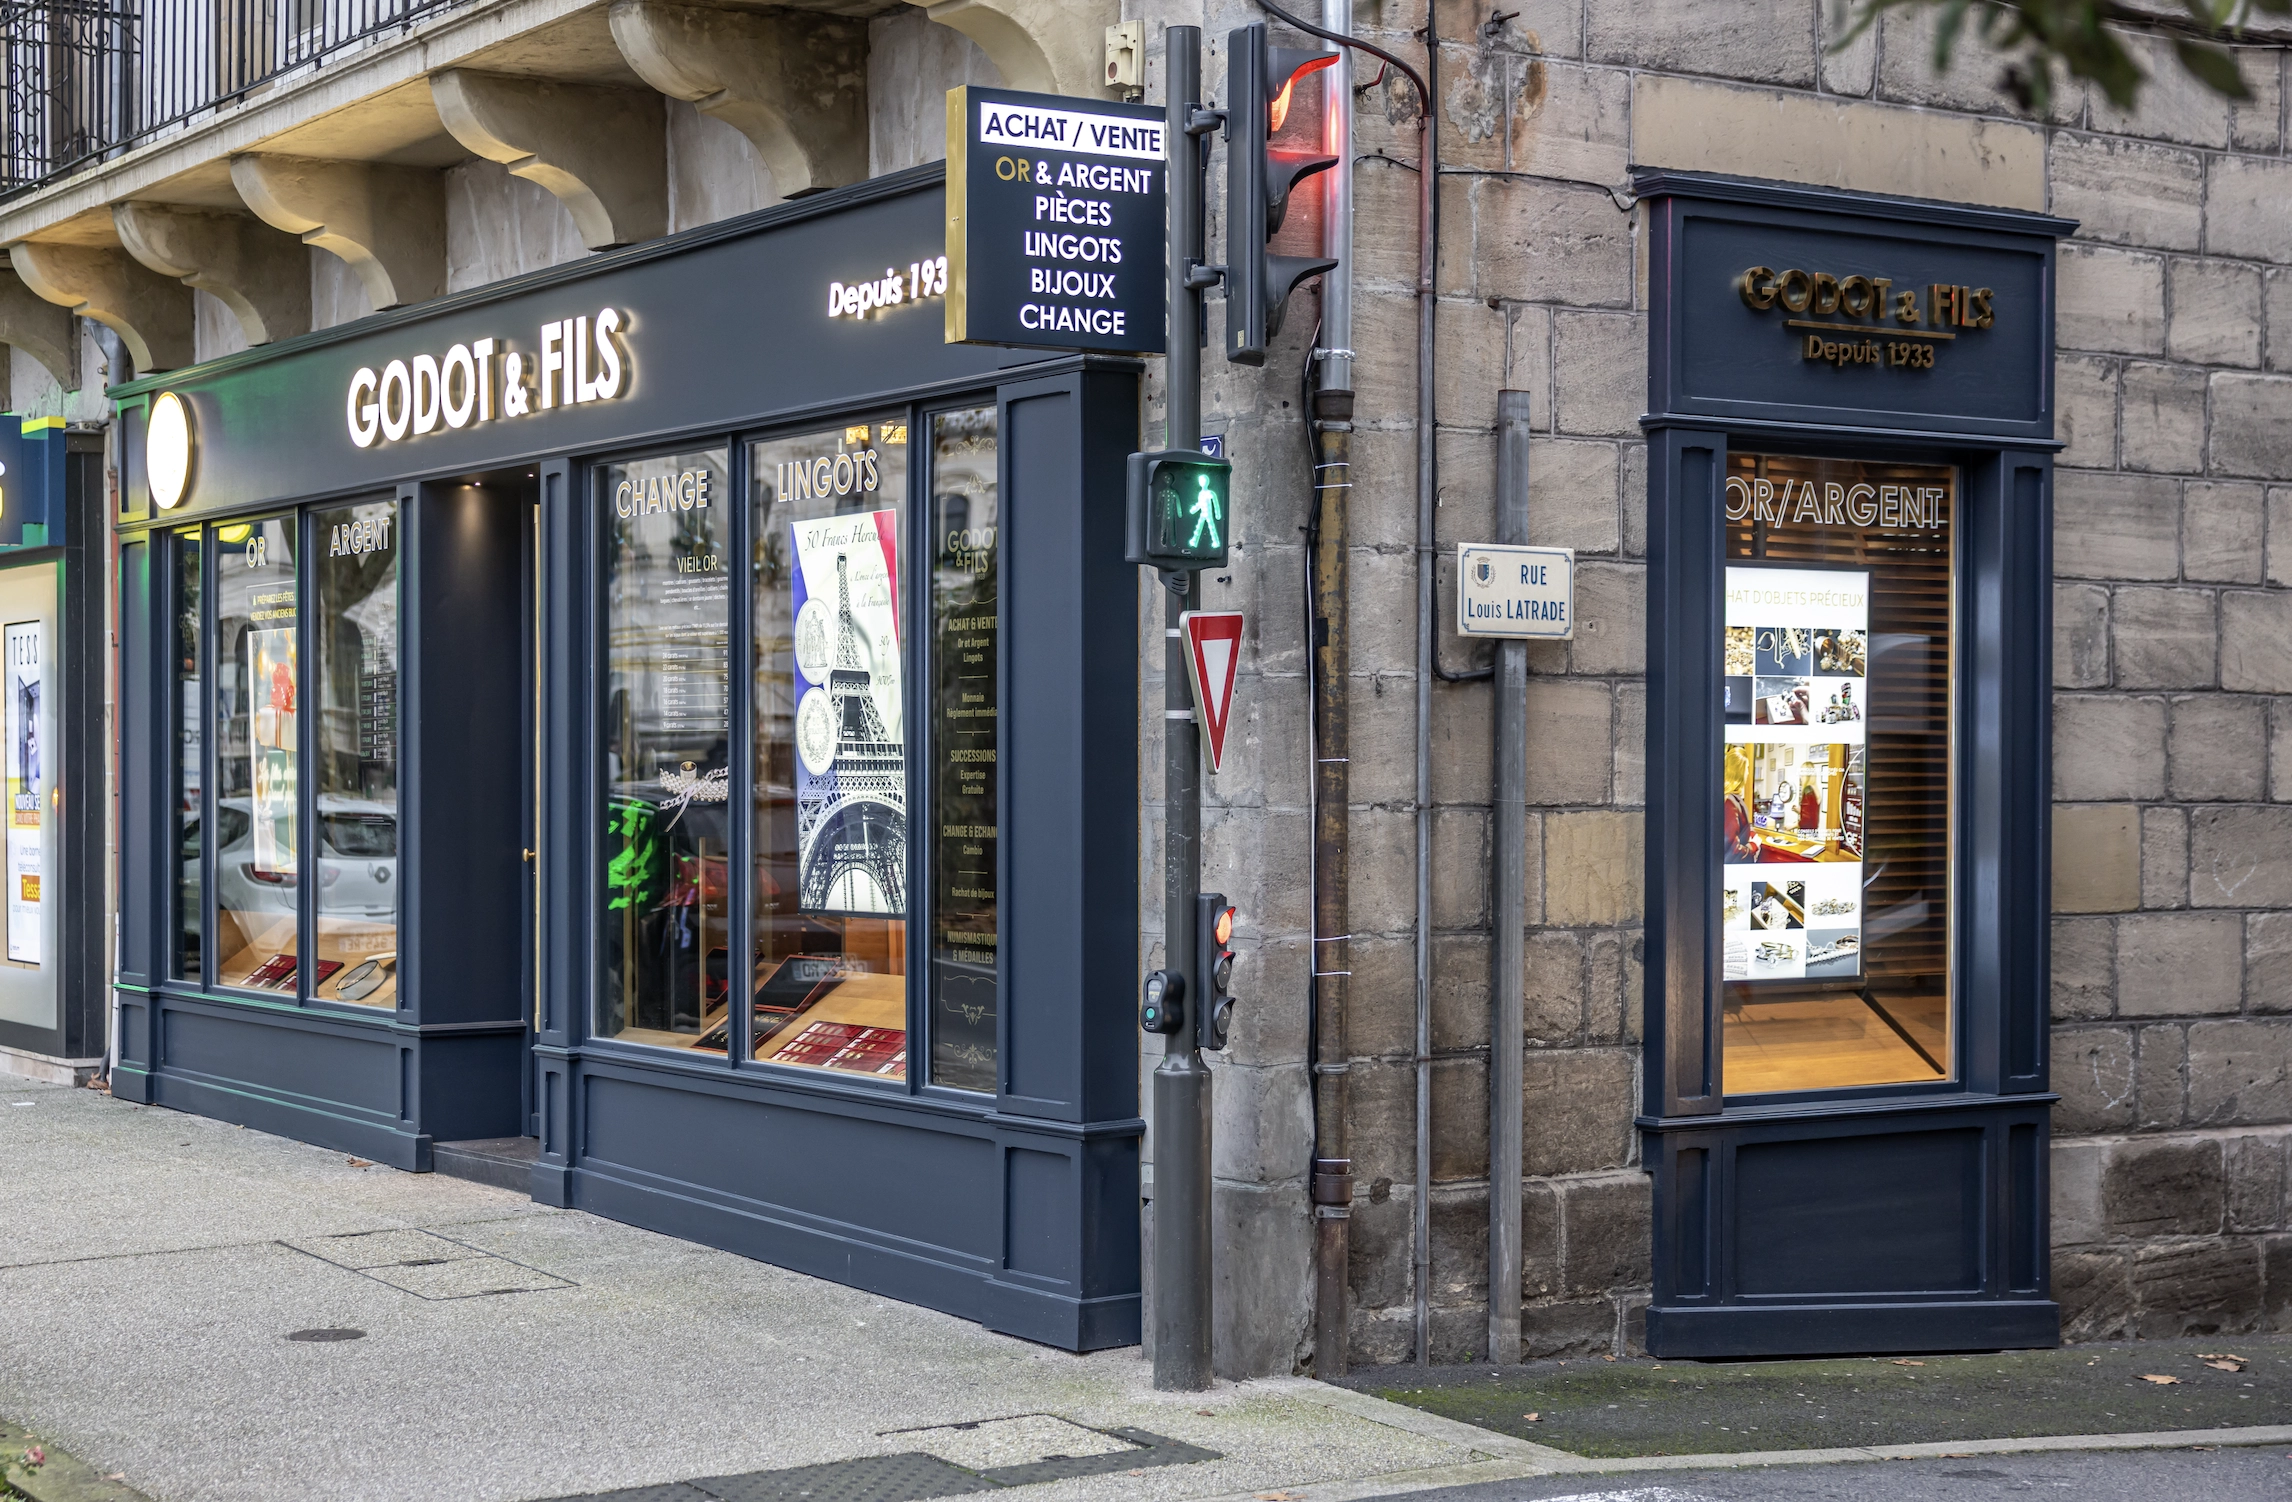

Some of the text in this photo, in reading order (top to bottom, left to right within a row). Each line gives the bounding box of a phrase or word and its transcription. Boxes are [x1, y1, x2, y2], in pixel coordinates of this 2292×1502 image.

[985, 112, 1160, 152] ACHAT / VENTE
[995, 156, 1152, 194] OR & ARGENT
[1035, 190, 1112, 227] PIÈCES
[1025, 231, 1122, 264] LINGOTS
[828, 267, 903, 320] Depuis
[1031, 268, 1116, 299] BIJOUX
[1739, 265, 1995, 329] GODOT & FILS
[1020, 304, 1126, 336] CHANGE
[1803, 335, 1935, 368] Depuis 1933
[346, 307, 624, 448] GODOT & FILS
[777, 449, 879, 503] LINGOTS
[616, 470, 709, 519] CHANGE
[1725, 476, 1944, 529] OR/ARGENT
[329, 517, 390, 557] ARGENT
[805, 513, 886, 551] 50 Francs Hercule
[246, 536, 267, 568] OR
[677, 554, 718, 574] VIEIL OR
[956, 550, 989, 574] & FILS
[1520, 564, 1547, 585] RUE
[1468, 597, 1565, 621] Louis LATRADE
[1753, 590, 1806, 606] D'OBJETS
[1810, 588, 1864, 607] PRÉCIEUX
[948, 617, 970, 631] ACHAT
[971, 617, 976, 630] &
[958, 637, 990, 649] Or et Argent
[963, 652, 983, 664] Lingots
[962, 692, 985, 702] Monnaie
[946, 707, 974, 719] Règlement
[950, 749, 997, 762] SUCCESSIONS
[960, 769, 986, 781] Expertise
[962, 784, 985, 795] Gratuite
[943, 825, 997, 838] CHANGE & ECHAN
[963, 844, 983, 856] Cambio
[951, 886, 995, 899] Rachat de bijoux
[953, 947, 994, 964] & MÉDAILLES
